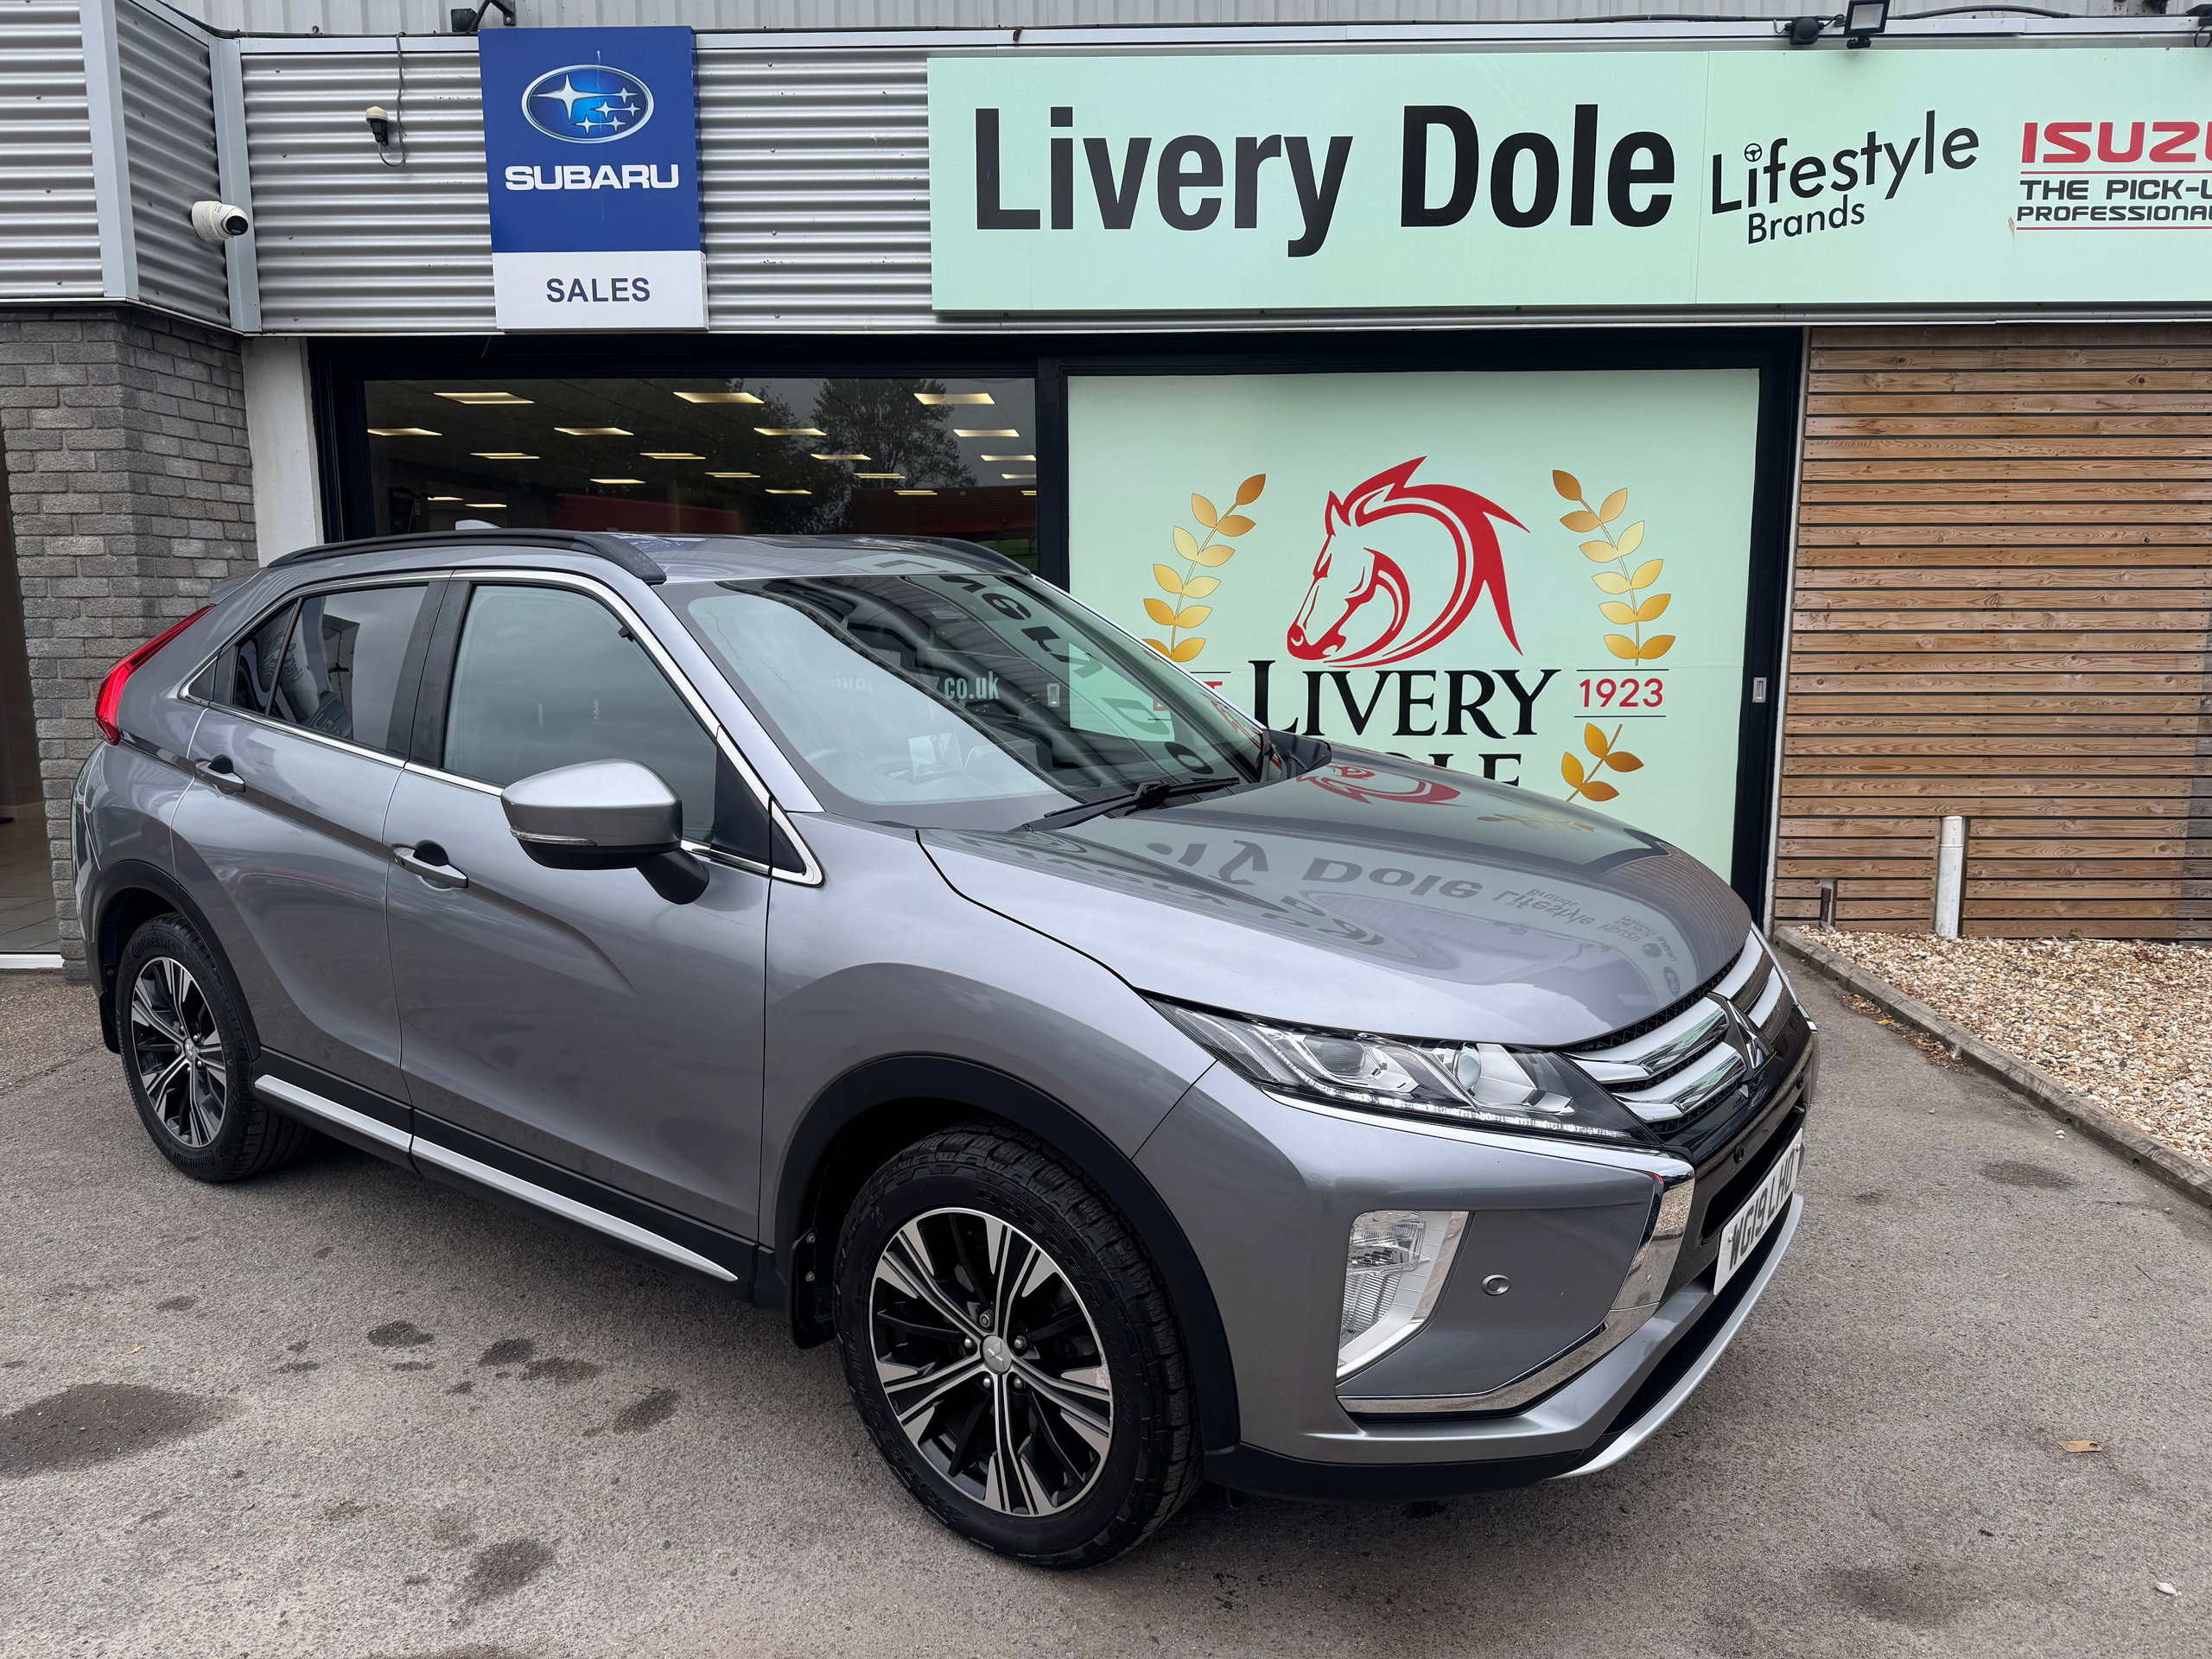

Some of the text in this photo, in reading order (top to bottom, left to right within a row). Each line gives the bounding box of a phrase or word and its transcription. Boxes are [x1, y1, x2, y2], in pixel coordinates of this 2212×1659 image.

[1711, 110, 1980, 215] Lifestyle
[2021, 121, 2212, 163] ISUZ
[505, 163, 680, 191] SUBARU
[975, 104, 1676, 258] Livery Dole
[2019, 179, 2089, 200] THE
[1746, 193, 1866, 245] Brands
[2017, 205, 2212, 222] PROFESSIONA
[546, 276, 652, 303] SALES
[1248, 659, 1562, 740] LIVERY
[1579, 677, 1665, 709] 1923
[1729, 1186, 1769, 1272] WG19
